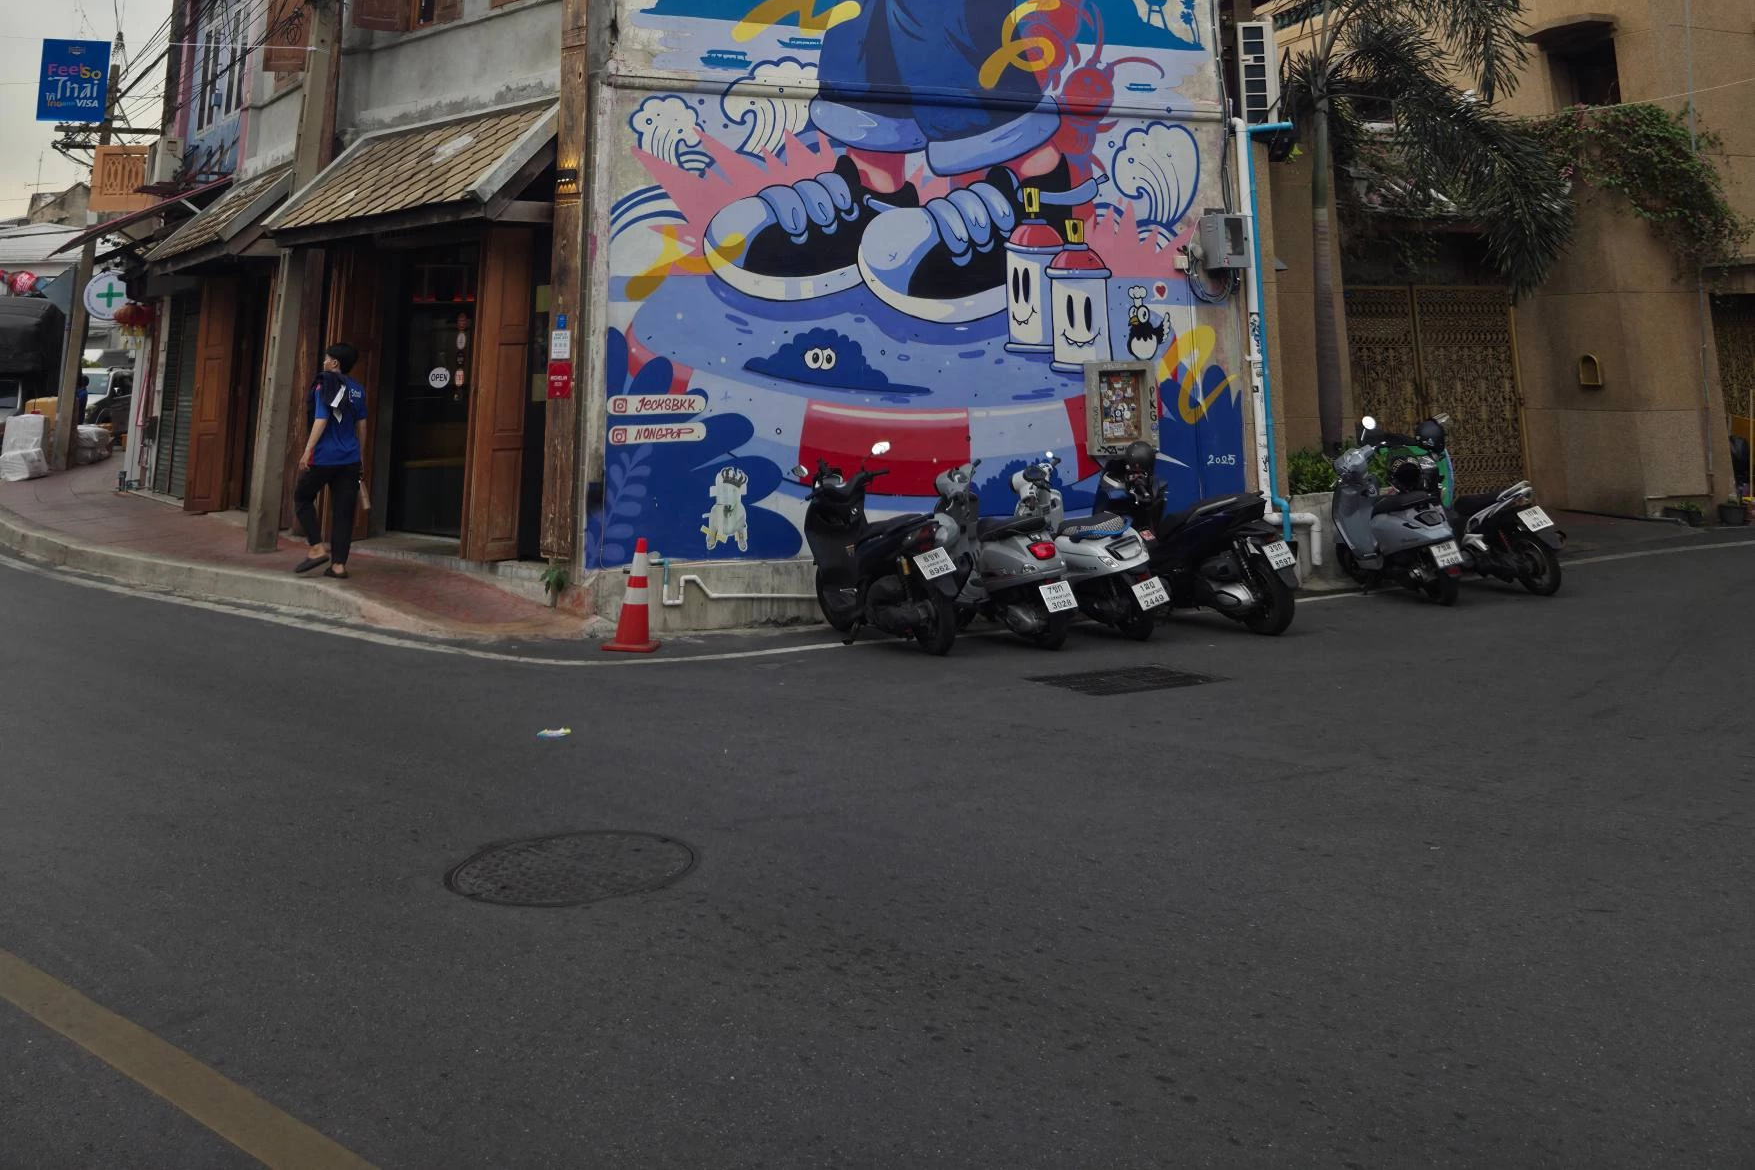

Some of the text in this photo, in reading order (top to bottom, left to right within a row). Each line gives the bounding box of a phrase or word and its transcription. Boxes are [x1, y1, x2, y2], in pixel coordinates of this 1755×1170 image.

[47, 76, 99, 99] Thai
[75, 99, 99, 108] VISA
[430, 373, 448, 382] OPEN
[1207, 454, 1236, 465] 2025
[1144, 594, 1165, 607] 2449
